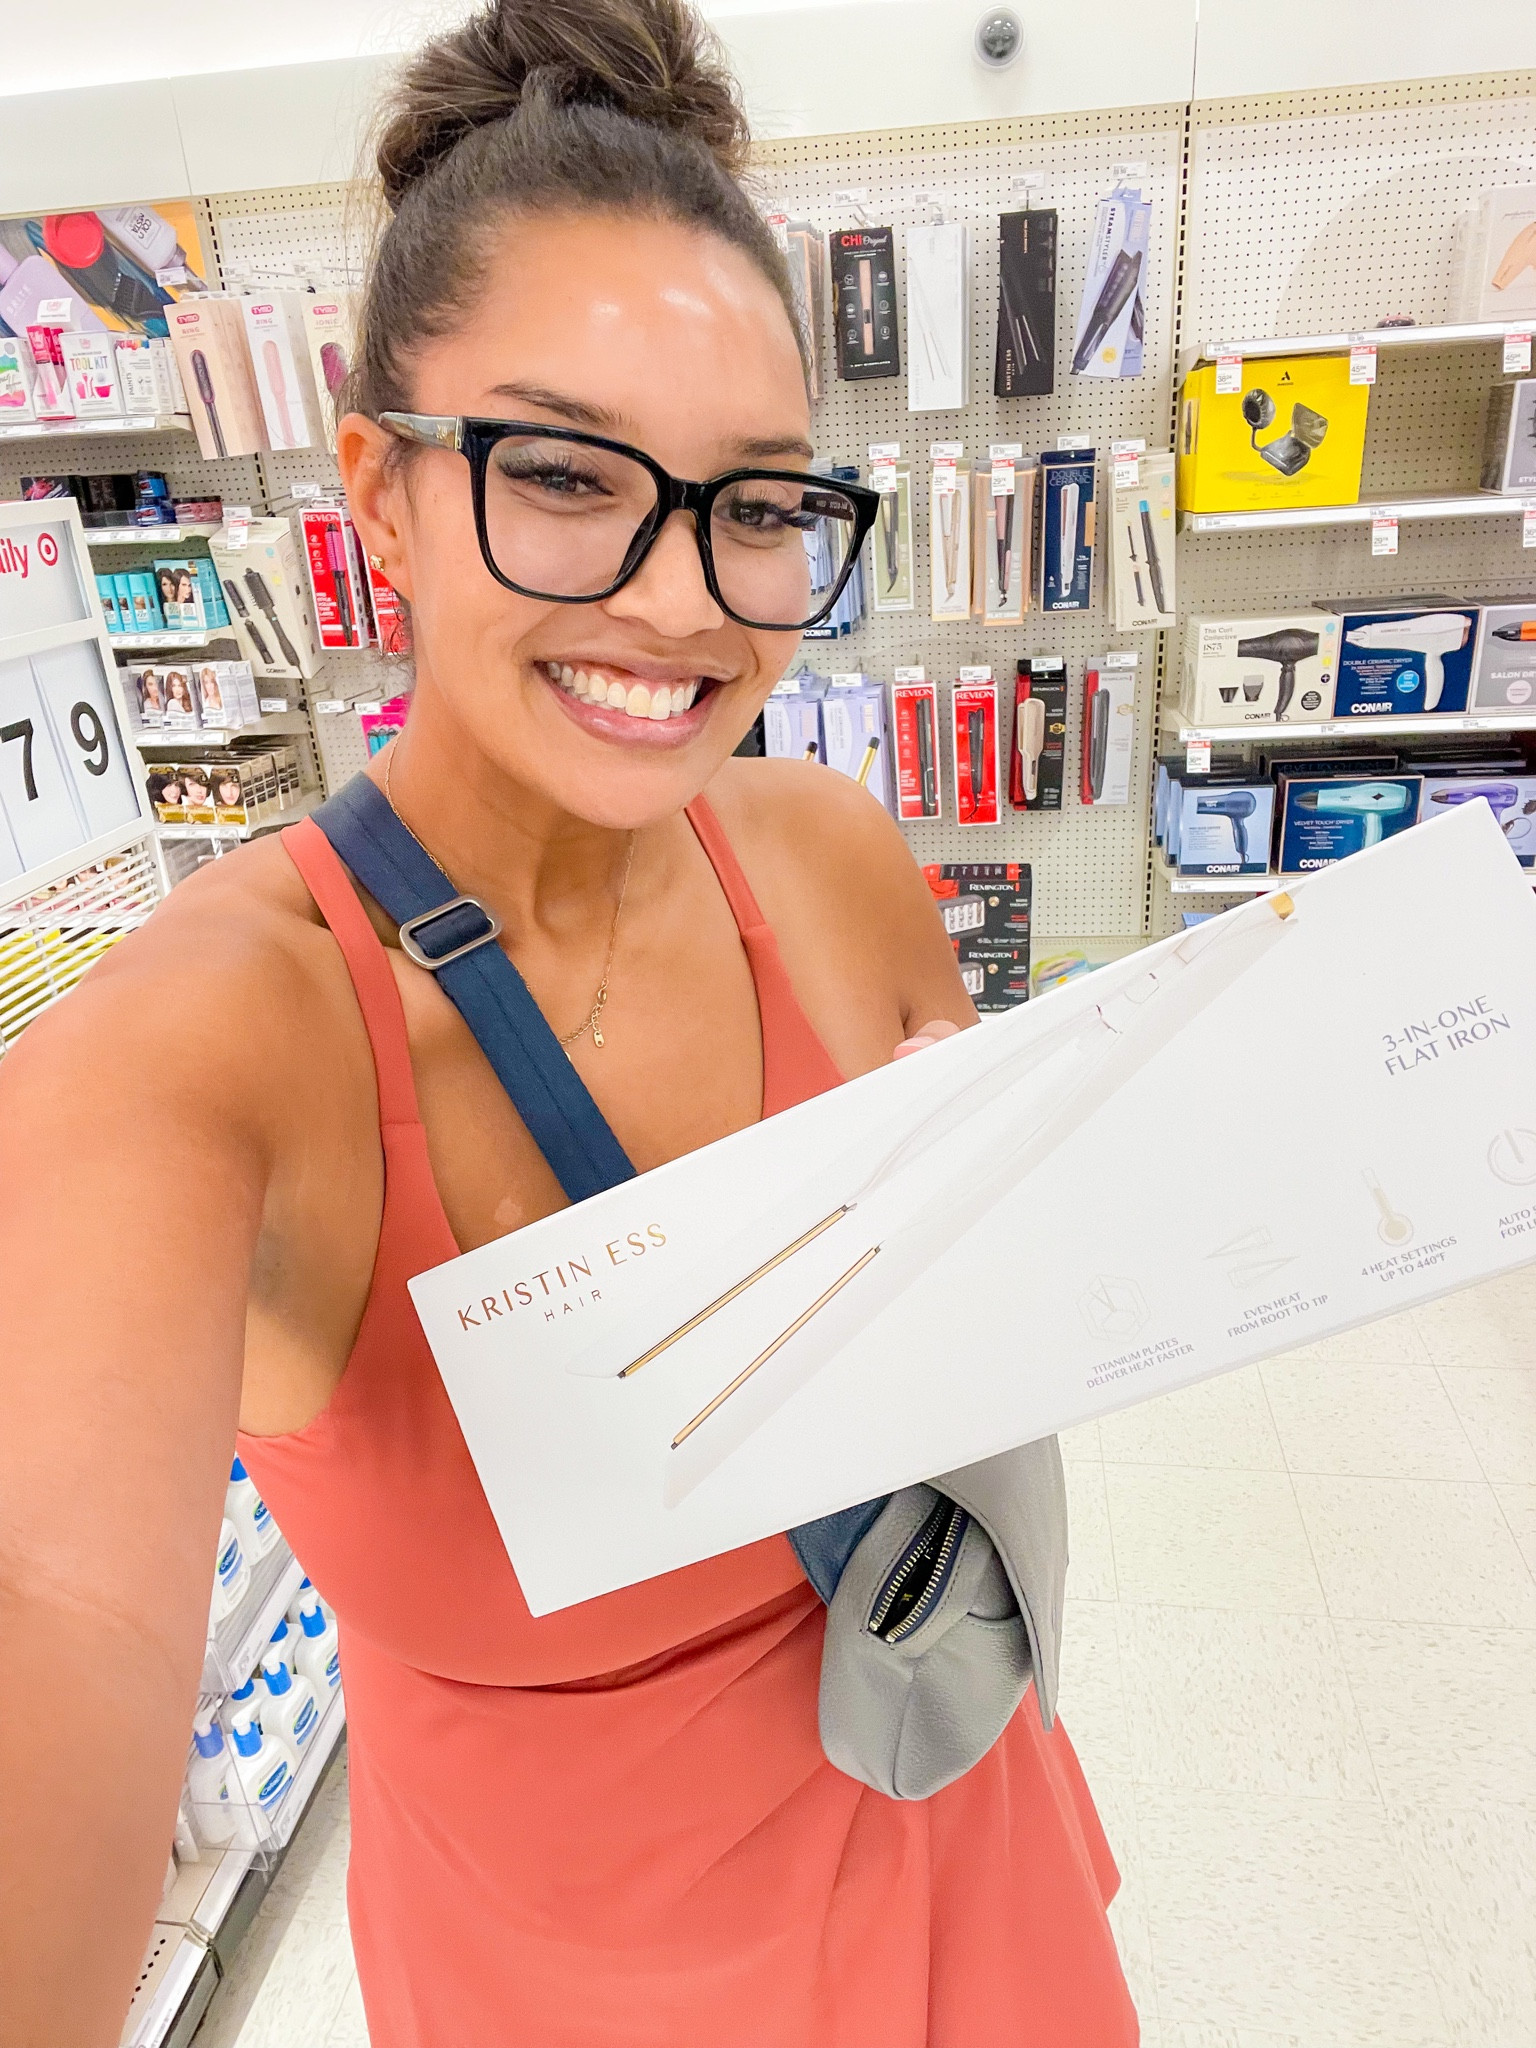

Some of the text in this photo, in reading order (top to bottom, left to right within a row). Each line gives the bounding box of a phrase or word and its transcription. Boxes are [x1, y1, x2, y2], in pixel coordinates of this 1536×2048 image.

[841, 235, 862, 246] CHI
[70, 355, 109, 371] TOOL KIT
[1050, 477, 1091, 487] CERAMIC
[1052, 469, 1089, 480] DOUBLE
[303, 513, 340, 523] REVLON
[1052, 601, 1080, 610] CONAIR
[804, 629, 832, 637] CONAIR
[1491, 671, 1523, 680] SALON
[895, 687, 933, 699] REVLON
[956, 690, 994, 700] REVLON
[1351, 702, 1393, 714] CONAIR
[1, 701, 109, 802] 7 9
[1206, 865, 1241, 873] CONAIR
[969, 883, 1014, 891] REMINGTON
[968, 951, 1012, 959] REMINGTON
[1382, 995, 1494, 1052] 3-IN-ONE
[1384, 1013, 1511, 1076] FLAT IRON
[1499, 1209, 1531, 1228] AUTO
[1500, 1223, 1526, 1239] FOR
[1361, 1235, 1458, 1277] 4 HEAT SETTINGS
[457, 1223, 667, 1331] KRISTIN ESS
[1379, 1270, 1396, 1283] UP
[1397, 1263, 1415, 1277] TO
[544, 1289, 602, 1322] HAIR
[1243, 1291, 1303, 1321] EVEN HEAT
[1227, 1294, 1329, 1338] FROM ROOT TO TIP
[1092, 1337, 1180, 1375] TITANIUM PLATES
[1086, 1343, 1195, 1389] DELIVER HEAT FASTER
